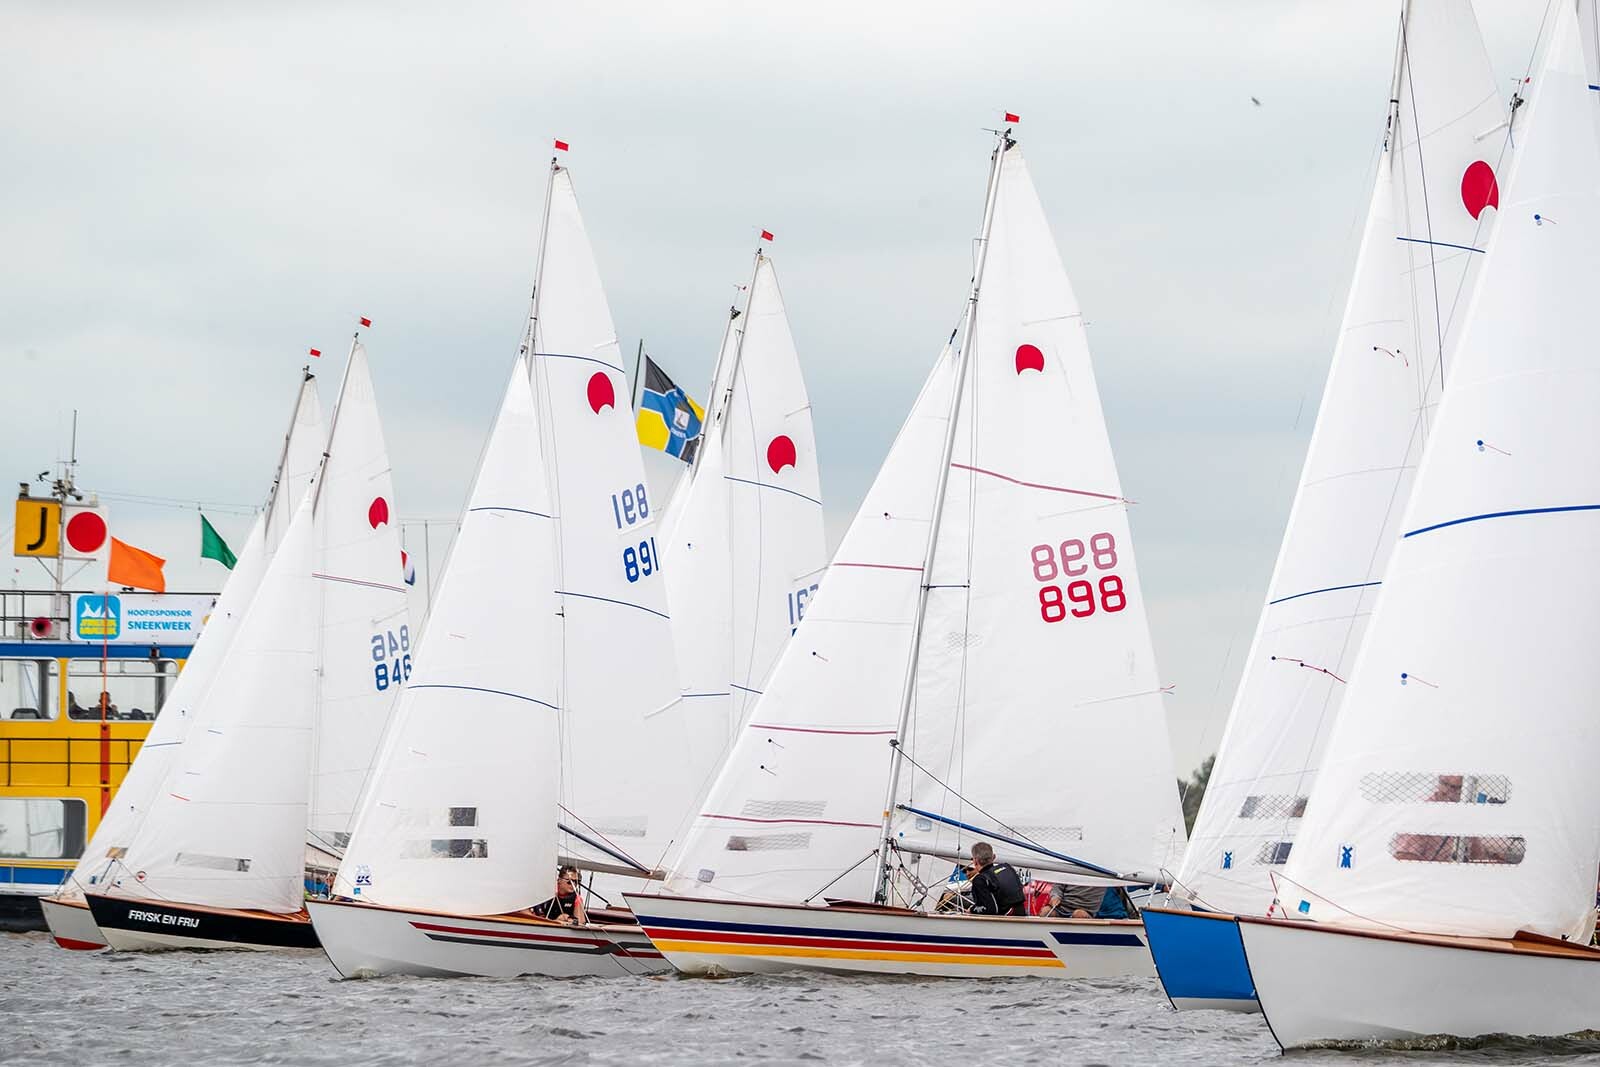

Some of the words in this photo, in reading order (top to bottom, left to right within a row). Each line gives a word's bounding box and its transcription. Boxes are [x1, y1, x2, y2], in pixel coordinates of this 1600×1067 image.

[27, 507, 48, 551] J
[623, 537, 659, 583] 891
[127, 609, 192, 617] HOOFDSPONSOR
[1039, 575, 1126, 623] 898
[127, 620, 191, 631] SNEEKWEEK
[374, 654, 412, 691] 846
[128, 909, 161, 924] FRYSK
[162, 914, 177, 925] EN
[176, 916, 200, 928] FRIJ
